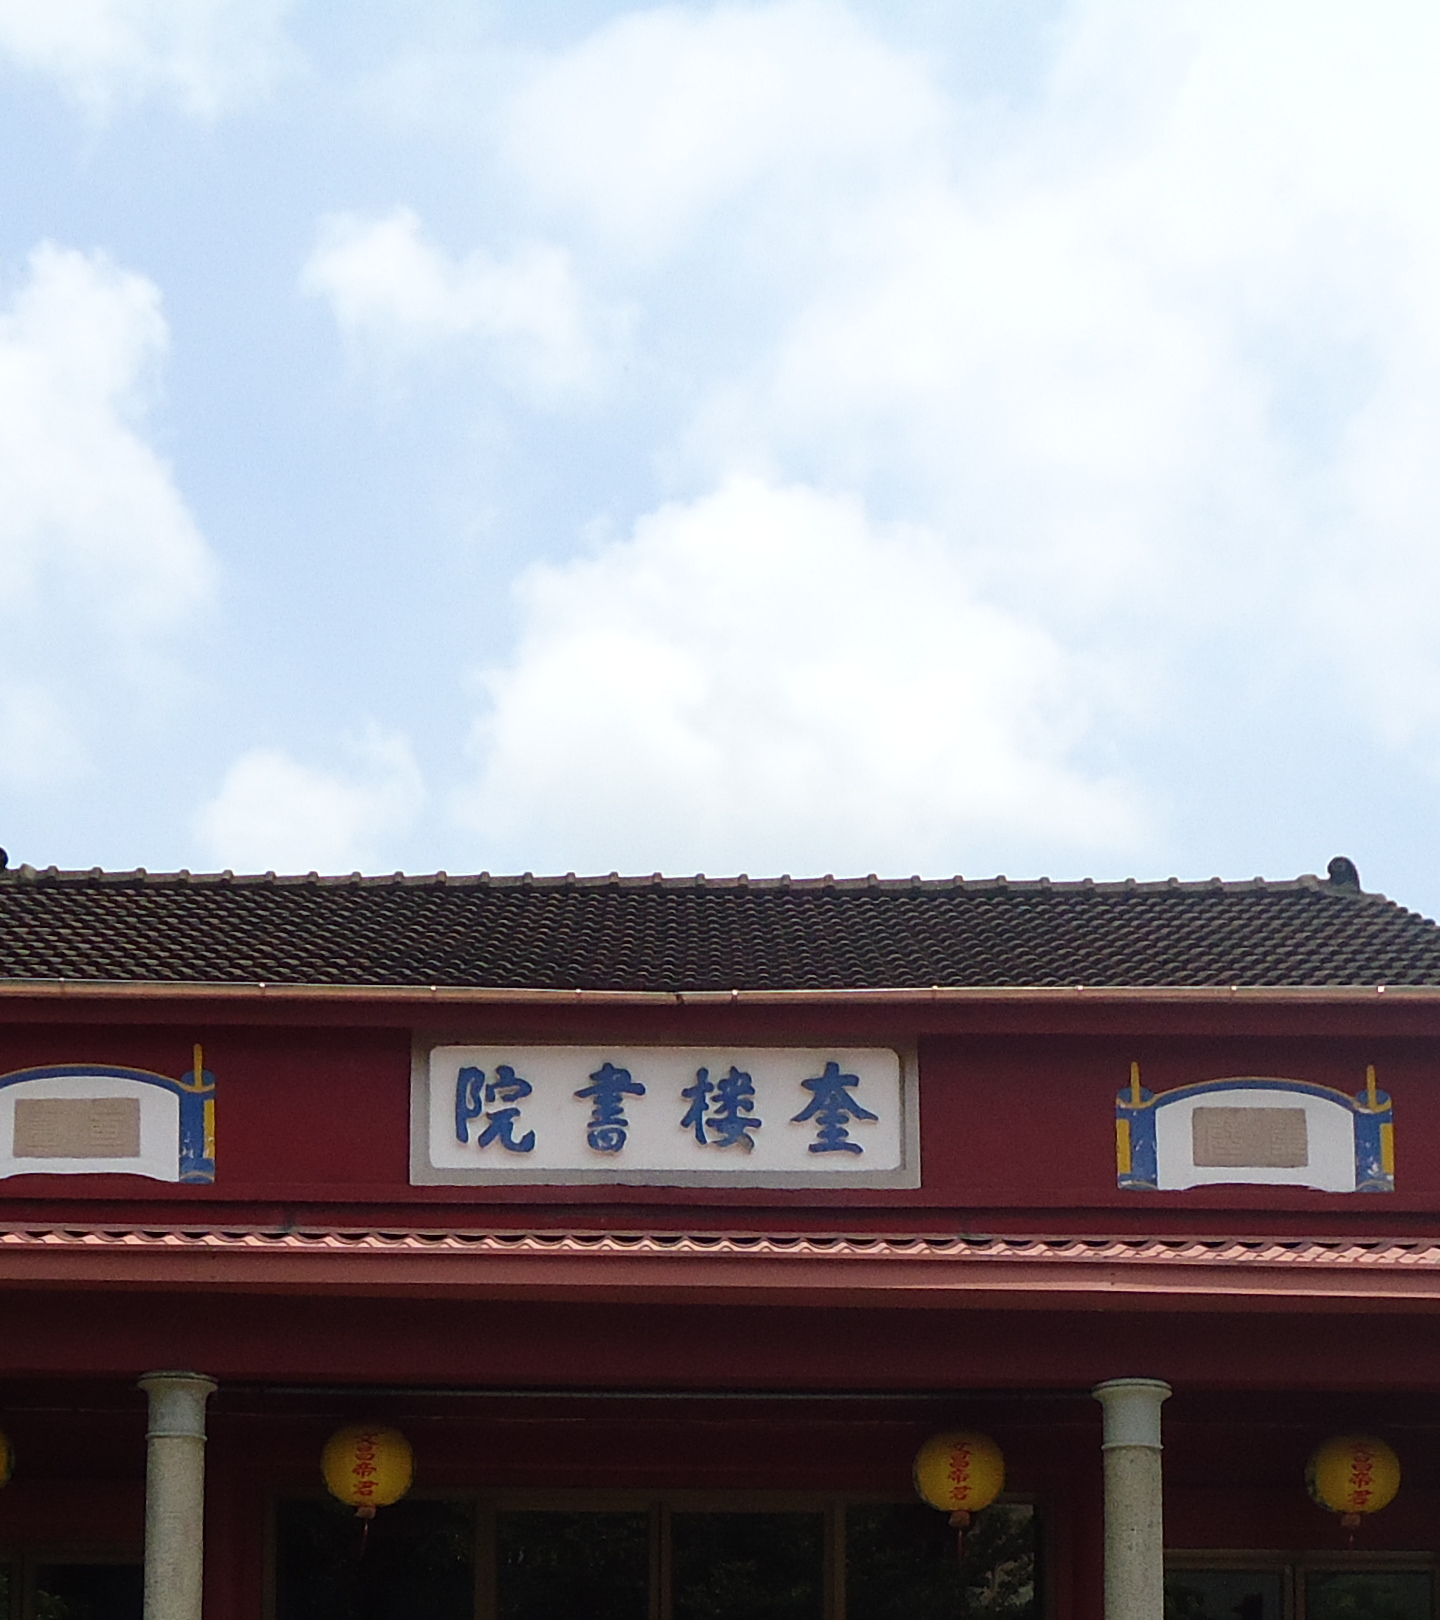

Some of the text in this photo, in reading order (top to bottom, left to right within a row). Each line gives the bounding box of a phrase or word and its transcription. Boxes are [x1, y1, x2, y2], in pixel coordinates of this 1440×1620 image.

[451, 1061, 879, 1154] 奎樓書院
[352, 1432, 381, 1497] 文昌帝君
[947, 1441, 973, 1502] 文昌帝君
[1347, 1443, 1375, 1507] 文昌帝君
